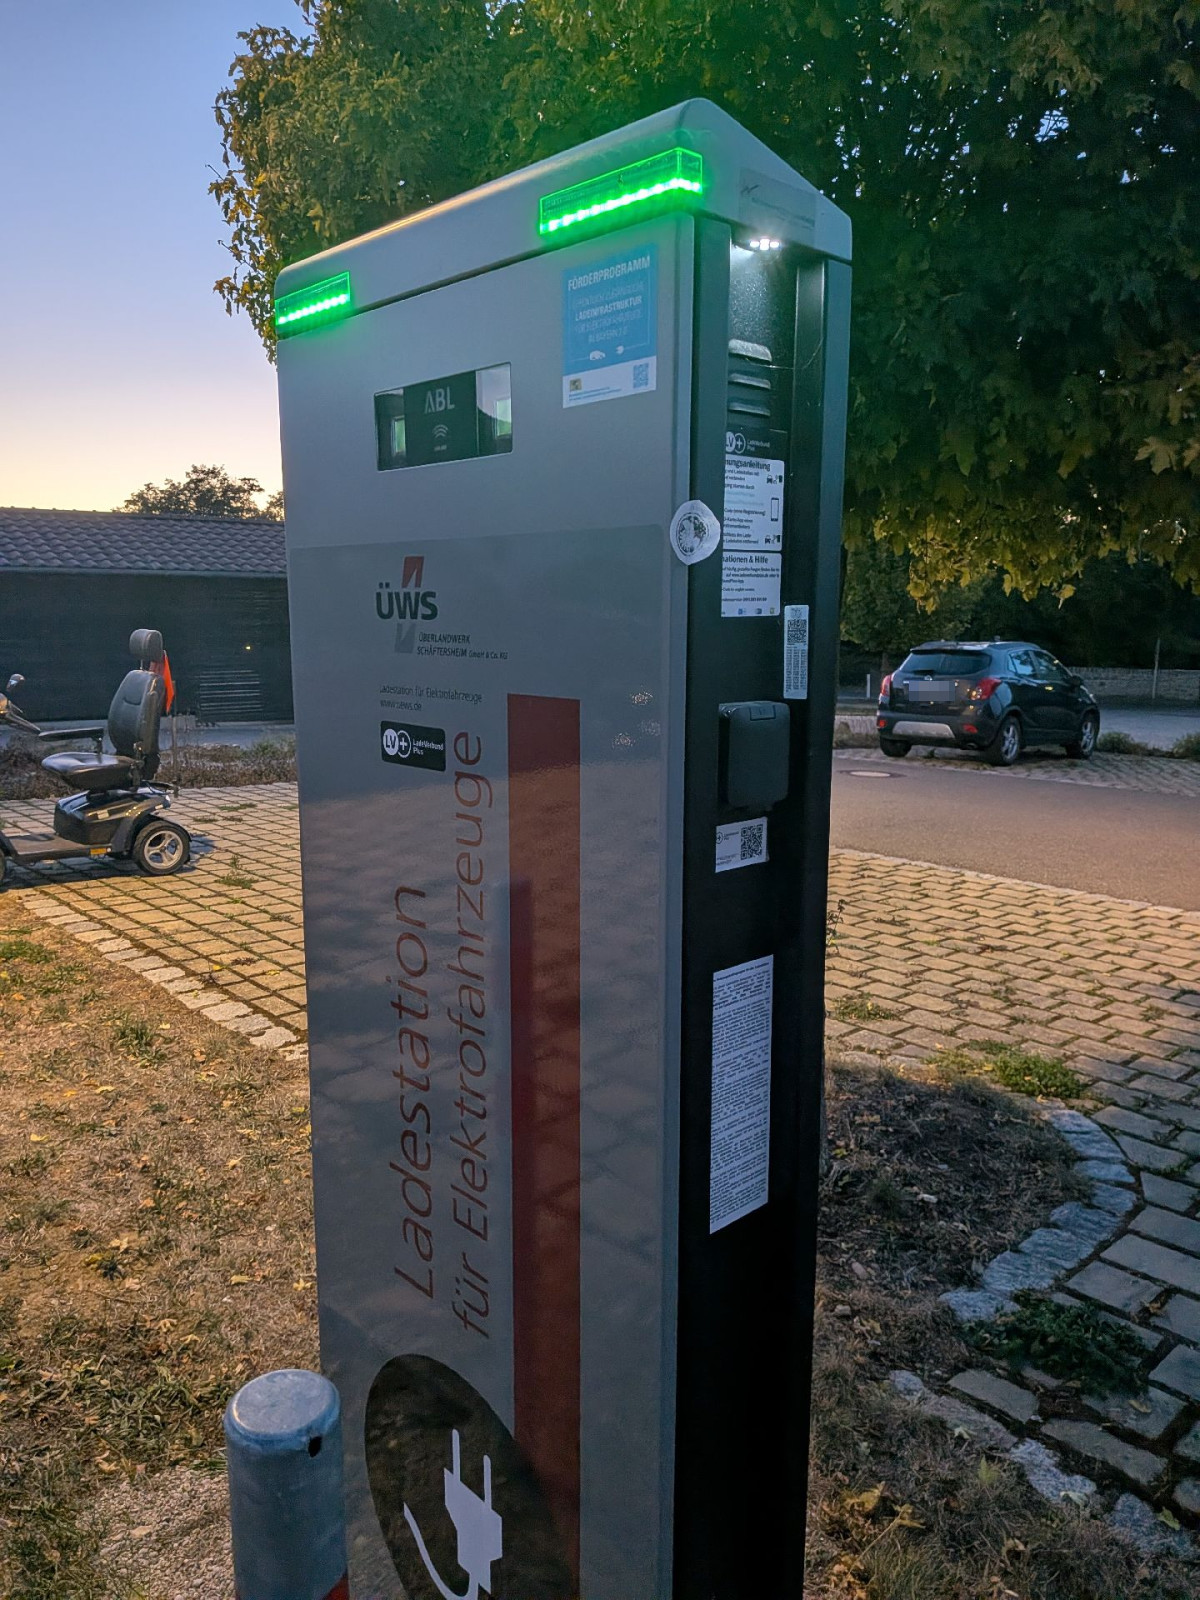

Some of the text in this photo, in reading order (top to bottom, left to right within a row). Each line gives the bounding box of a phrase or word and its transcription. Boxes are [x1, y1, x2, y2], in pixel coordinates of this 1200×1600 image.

[568, 255, 651, 291] FÖRDERPROGRAMM
[425, 386, 455, 414] ABL
[754, 556, 769, 564] Hilfe
[376, 582, 438, 620] ÜWS
[412, 739, 444, 751] LadeVerbund
[412, 747, 424, 756] Plus
[447, 731, 493, 1339] für Elektrofahrzeuge
[387, 885, 433, 1299] Ladestation
